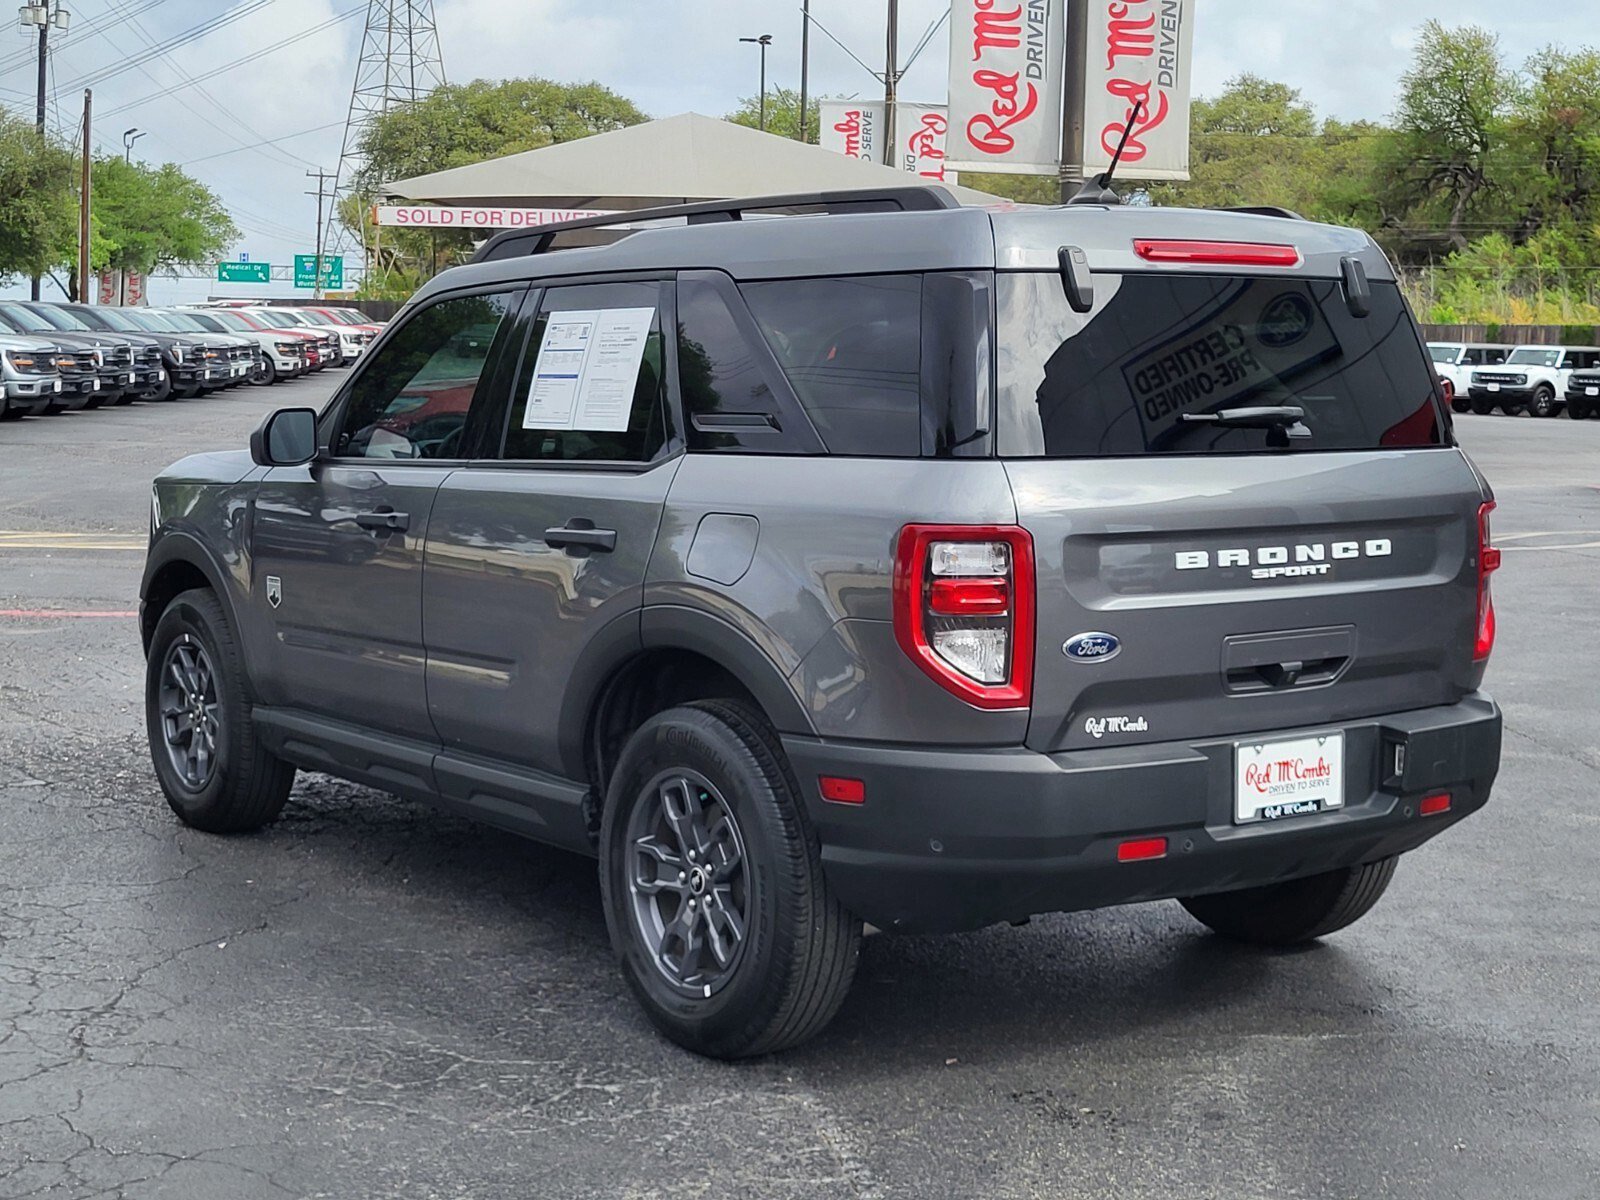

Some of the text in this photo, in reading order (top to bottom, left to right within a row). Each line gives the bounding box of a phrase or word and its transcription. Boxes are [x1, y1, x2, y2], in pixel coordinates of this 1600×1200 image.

[1157, 0, 1177, 88] DRIVEN
[1101, 0, 1168, 162] Red Mc
[966, 69, 1038, 154] Red
[834, 110, 860, 158] mbs
[861, 111, 873, 150] SERVE
[908, 113, 947, 159] Red
[396, 209, 454, 224] SOLD
[461, 211, 503, 226] FOR
[1175, 538, 1392, 570] BRONCO
[1251, 563, 1331, 580] SPORT
[1077, 638, 1109, 656] Ford
[1085, 716, 1148, 738] Red McCombs
[1245, 757, 1331, 793] Red McCombs
[1268, 778, 1331, 794] DRIVEN TO SERVE
